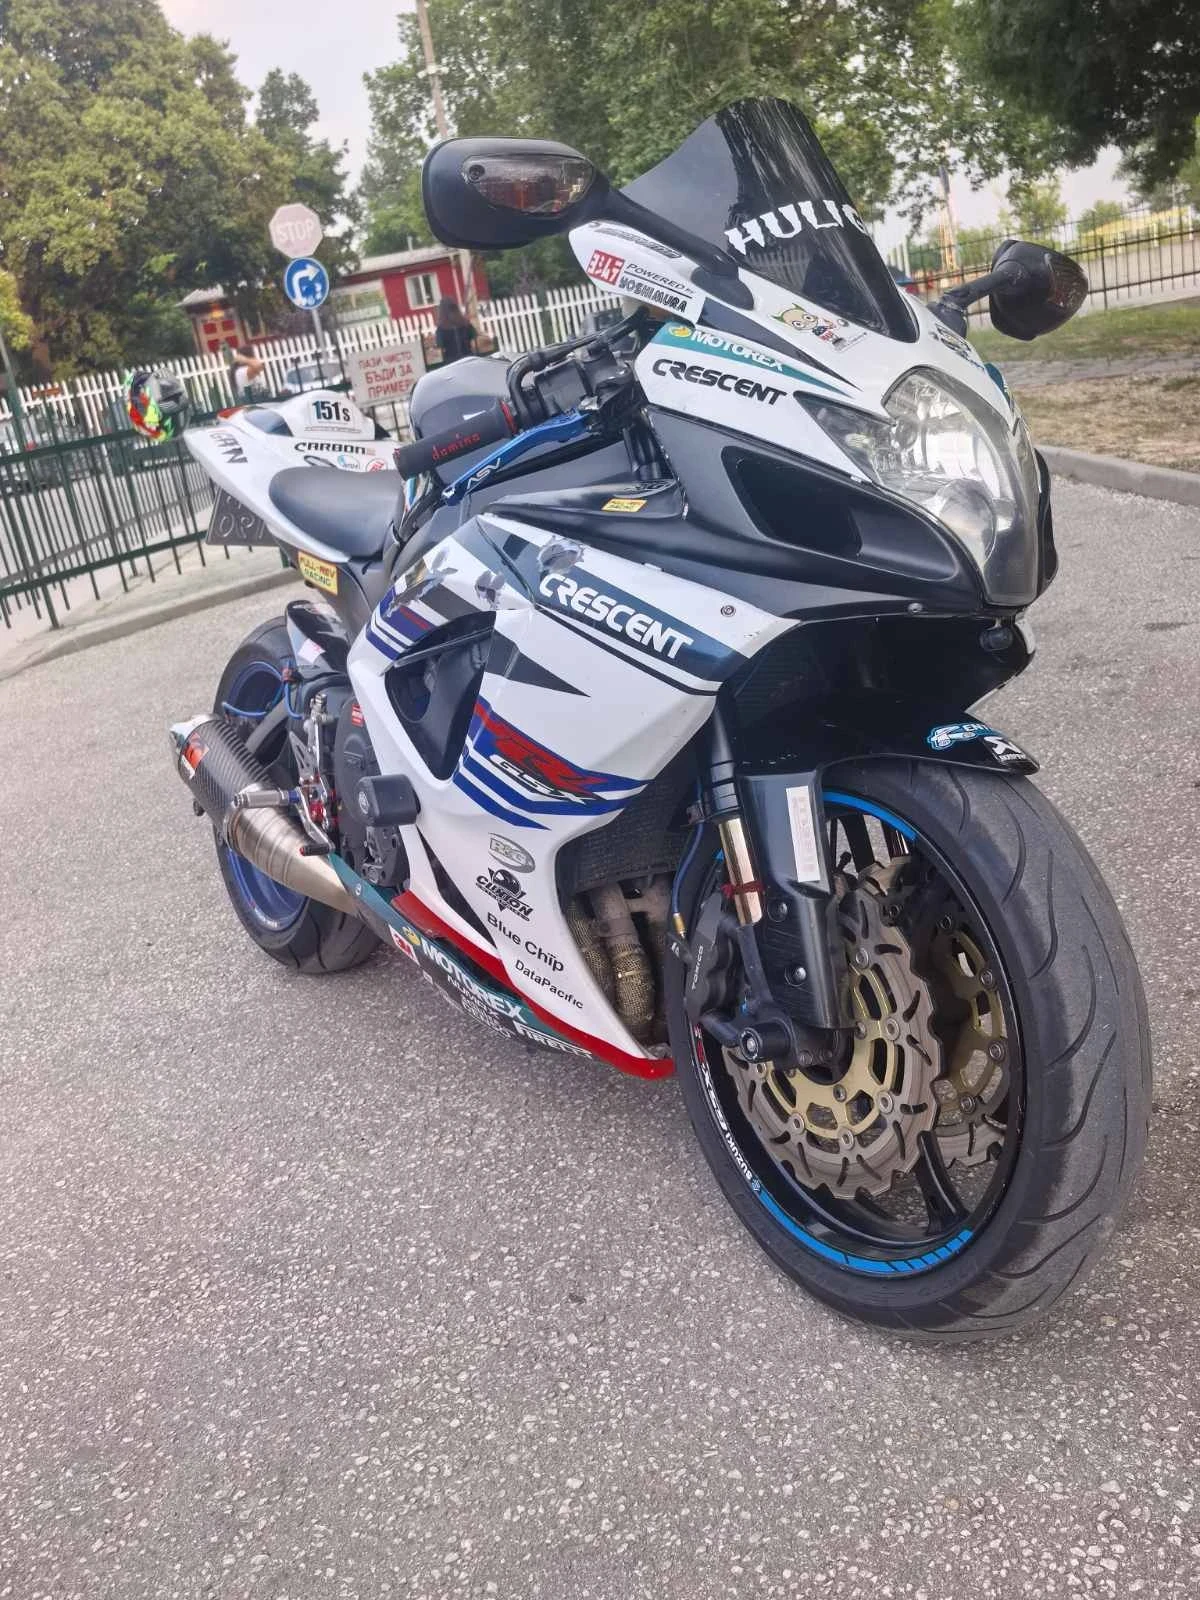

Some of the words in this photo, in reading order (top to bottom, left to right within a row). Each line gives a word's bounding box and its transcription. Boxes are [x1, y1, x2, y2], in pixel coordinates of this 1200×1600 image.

[275, 220, 315, 242] STOP
[618, 276, 688, 313] YOSHIMURA
[627, 263, 685, 290] POWERED
[691, 327, 785, 373] MOTOREX
[365, 368, 397, 384] БЪДИ
[399, 363, 413, 376] ЗА
[652, 358, 789, 406] CRESCENT
[294, 442, 366, 456] CARBON
[432, 432, 481, 460] domino
[466, 457, 501, 490] ASV
[539, 573, 694, 659] CRESCENT
[487, 911, 522, 946] Blue
[421, 937, 528, 1024] MOTOREX
[515, 959, 584, 1010] DataPacific
[514, 1020, 593, 1060] PIRELLI
[724, 1131, 753, 1181] SUZUKI
